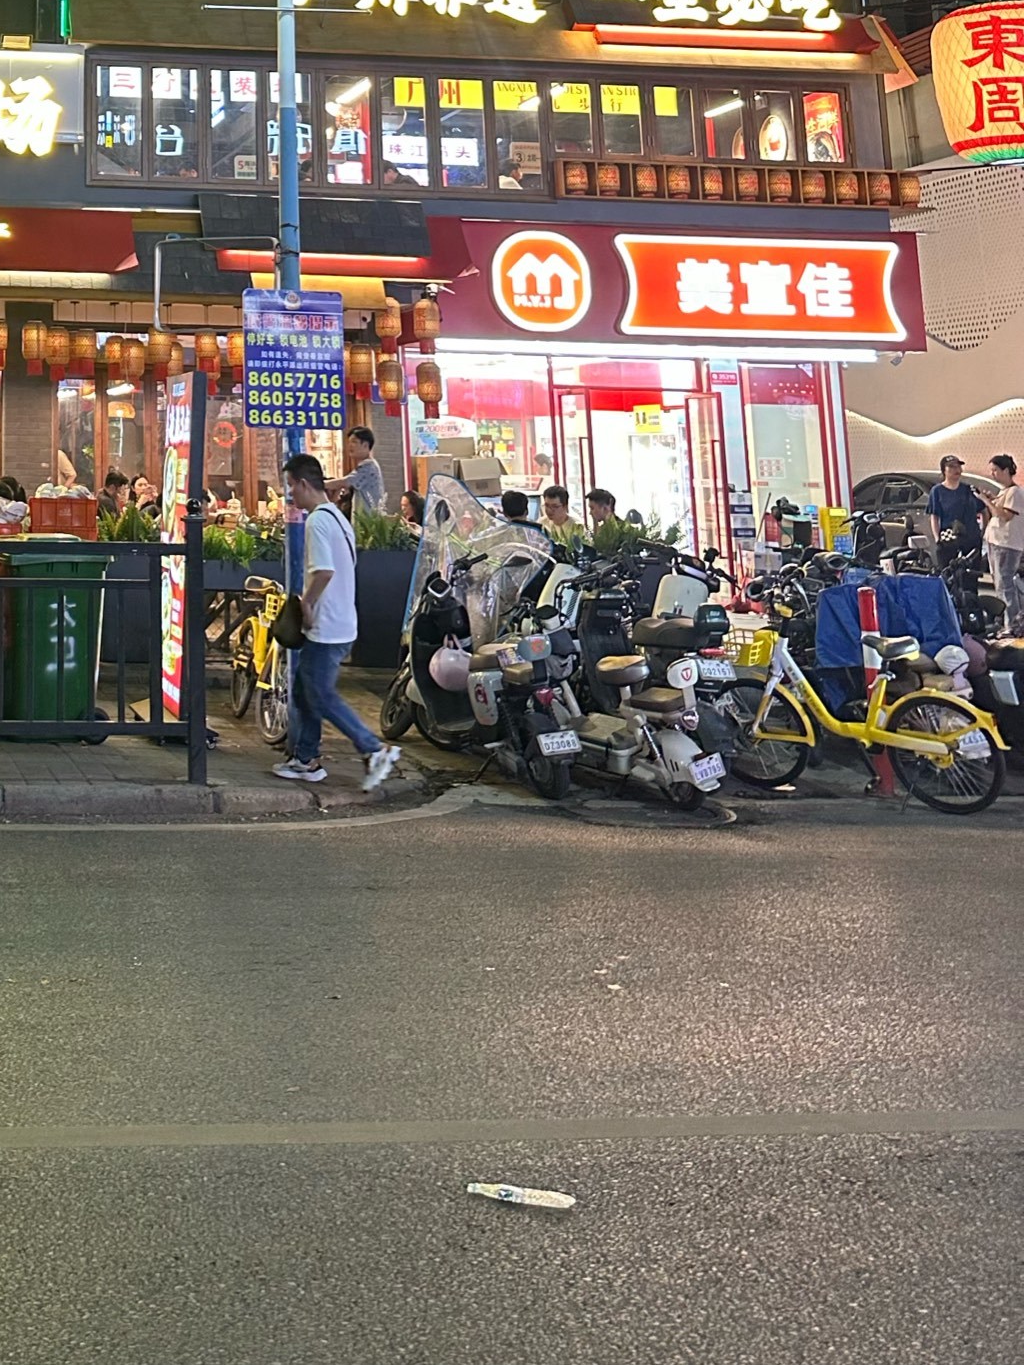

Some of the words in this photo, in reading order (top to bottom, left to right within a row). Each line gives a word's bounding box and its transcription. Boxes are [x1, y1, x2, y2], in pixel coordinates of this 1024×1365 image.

[676, 258, 856, 318] 美宜佳
[247, 370, 342, 390] 86057716
[247, 389, 342, 409] 86057758
[247, 408, 343, 428] 86633110
